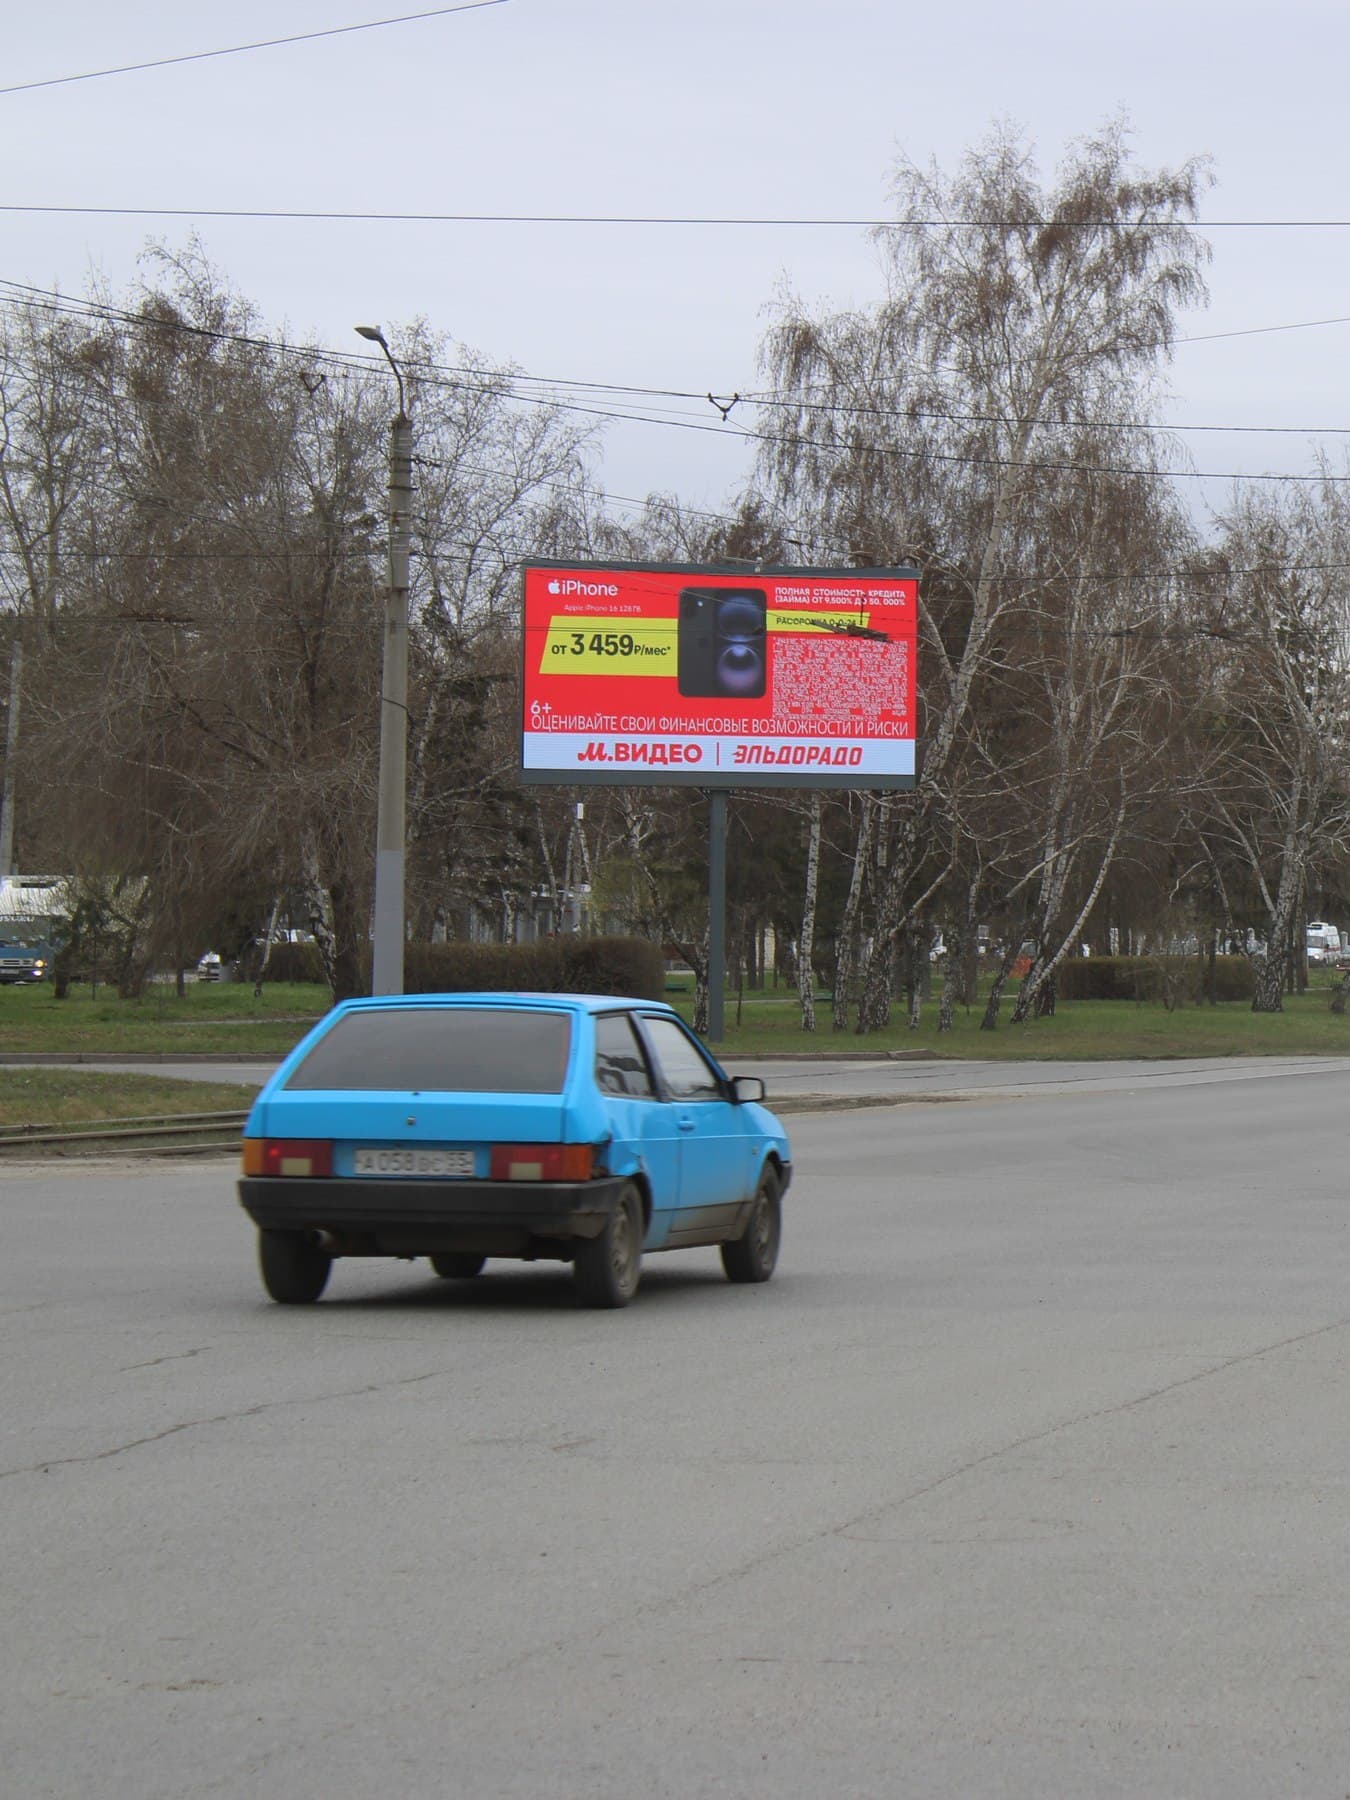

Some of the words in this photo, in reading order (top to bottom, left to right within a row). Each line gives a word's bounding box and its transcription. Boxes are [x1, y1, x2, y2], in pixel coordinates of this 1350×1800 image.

[562, 580, 618, 596] iPhone
[775, 586, 810, 596] ПОЛНАЯ
[868, 589, 906, 599] КРЕДИТА
[812, 596, 823, 604] ОТ
[530, 700, 552, 715] 6+
[531, 713, 617, 732] ОЦЕНИВАЙТЕ
[620, 715, 656, 731] СВОИ
[659, 716, 749, 733] ФИНАНСОВЫЕ
[752, 718, 851, 735] ВОЗМОЖНОСТИ
[855, 721, 864, 735] И
[867, 721, 908, 736] РИСКИ
[577, 742, 703, 765] М.ВИДЕО
[731, 744, 863, 766] ЭЛЬДОРАДО
